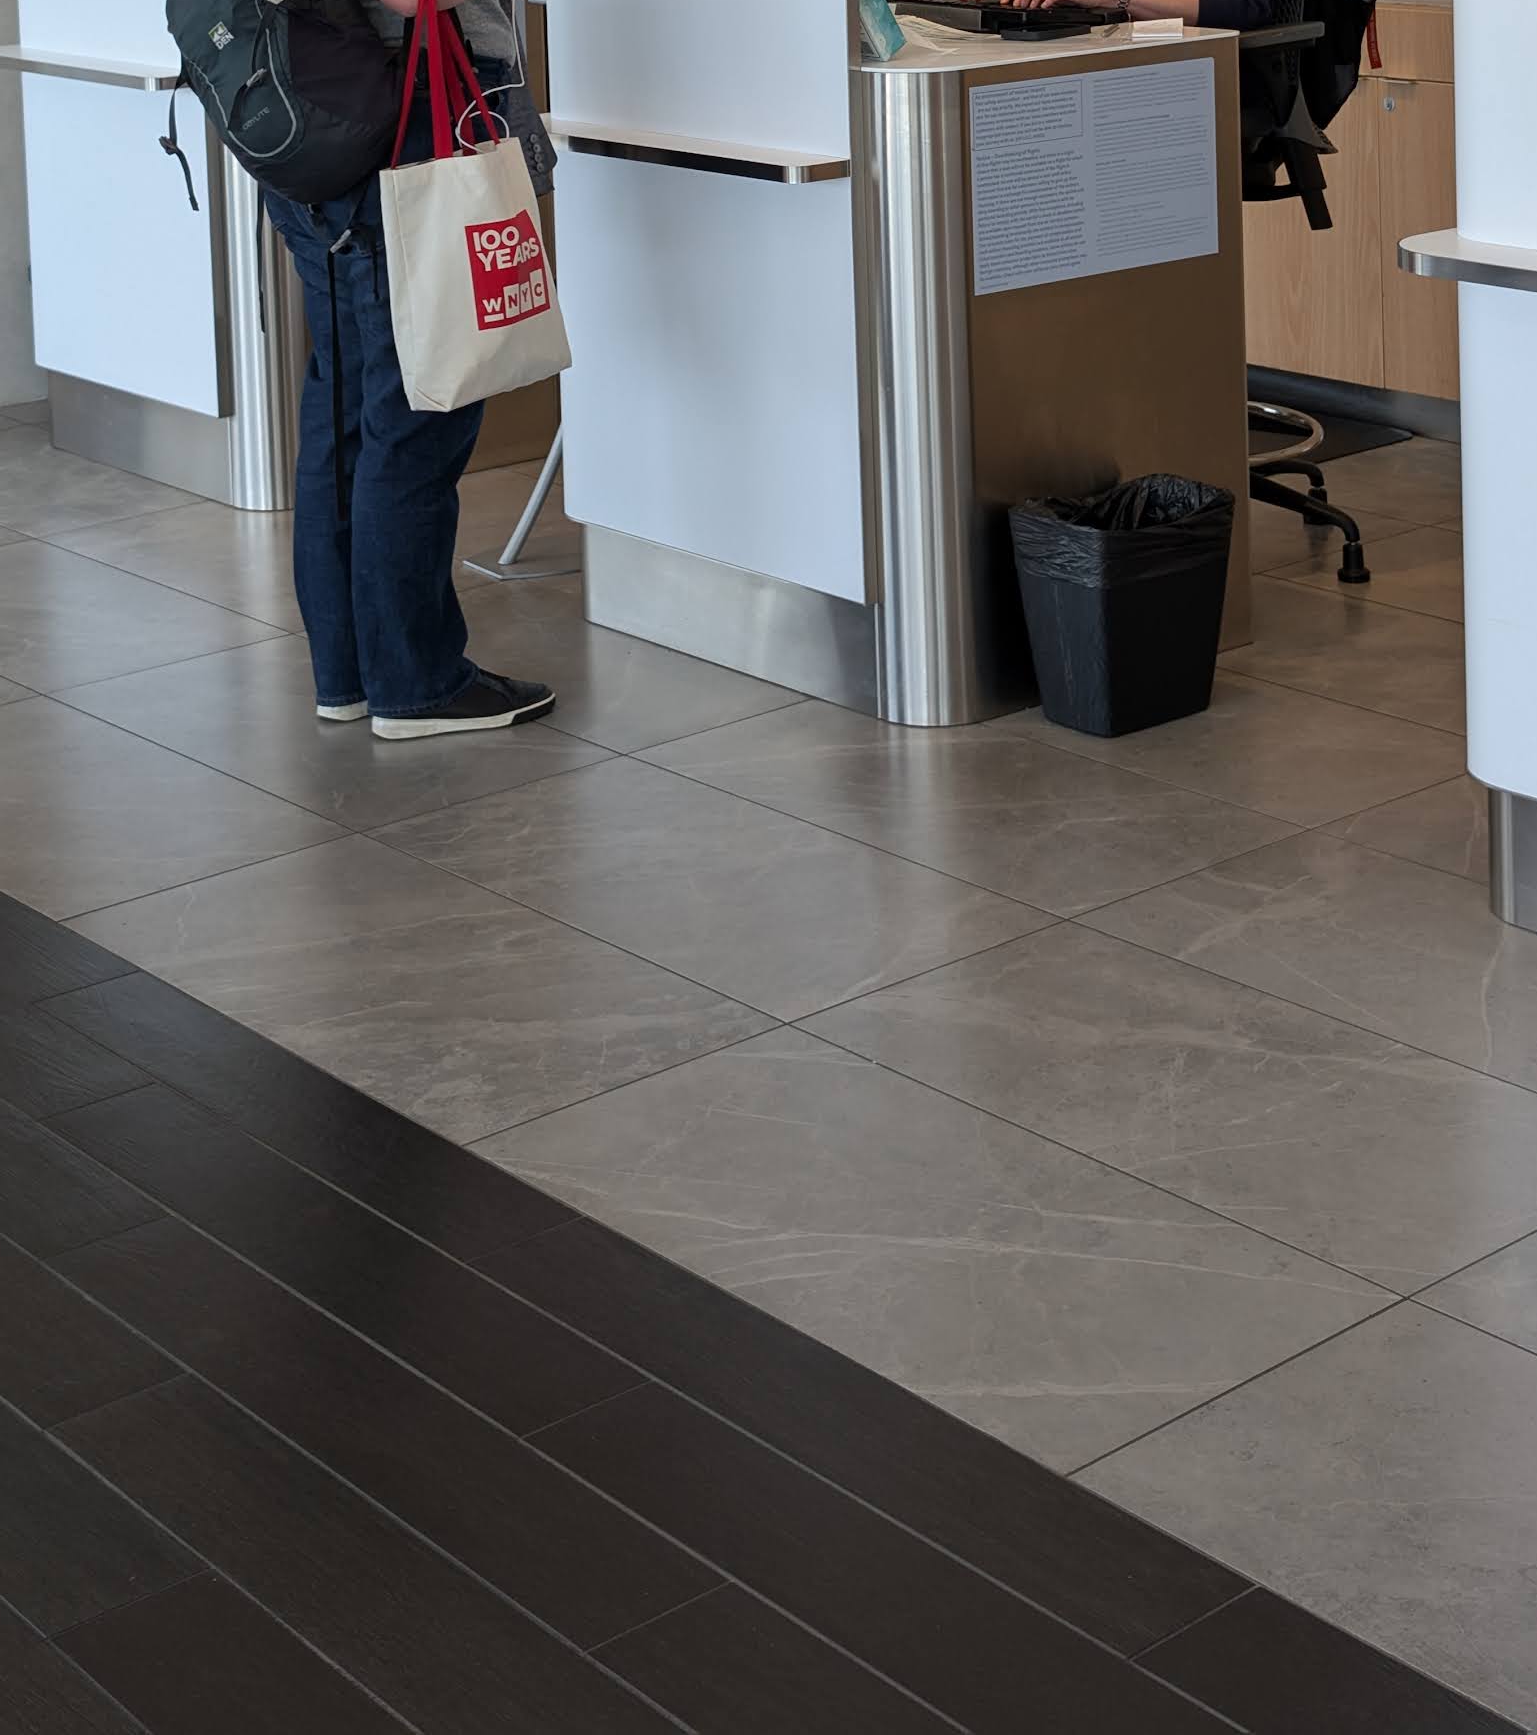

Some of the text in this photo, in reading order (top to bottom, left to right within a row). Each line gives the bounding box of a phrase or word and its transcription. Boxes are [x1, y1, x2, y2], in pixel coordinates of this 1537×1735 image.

[216, 33, 235, 51] DEN
[473, 225, 520, 253] 100
[477, 237, 540, 272] YEARS
[483, 279, 545, 317] WNYC
